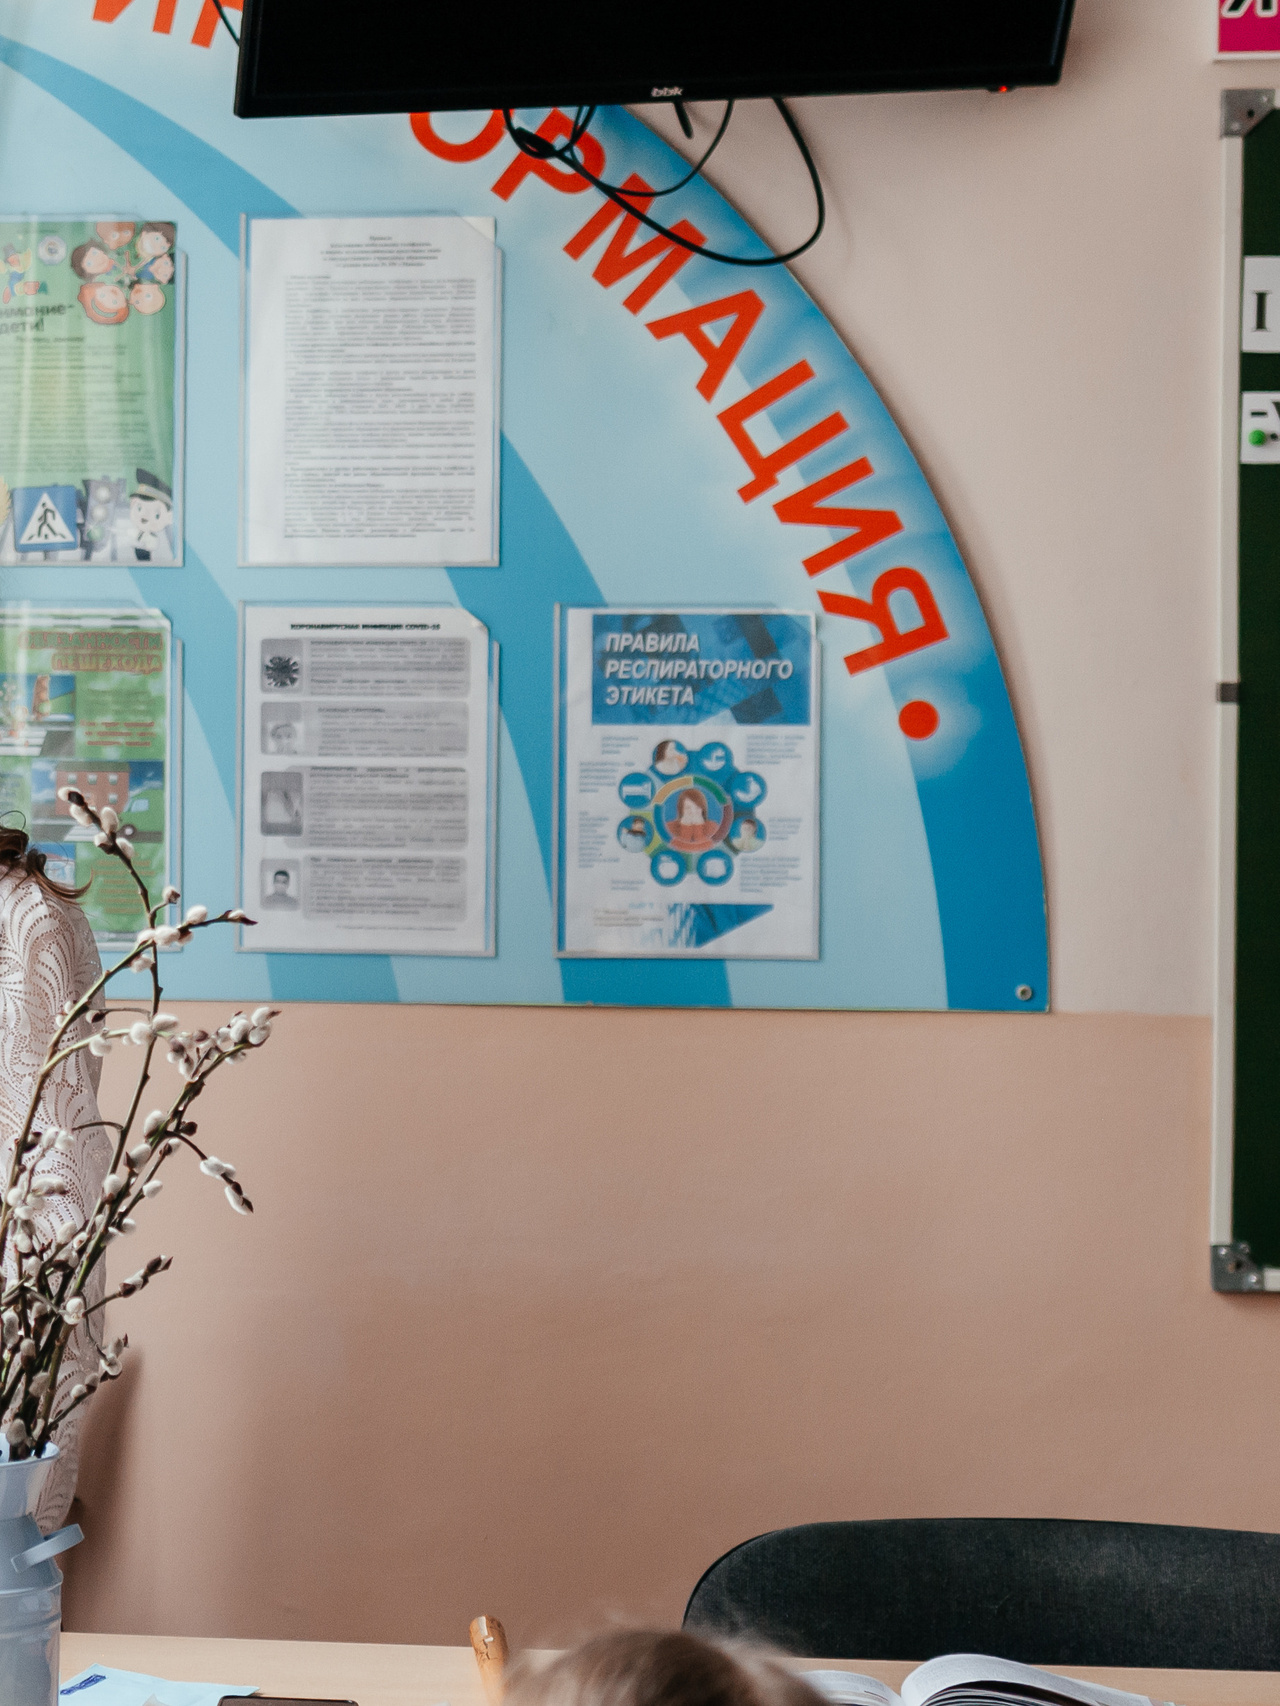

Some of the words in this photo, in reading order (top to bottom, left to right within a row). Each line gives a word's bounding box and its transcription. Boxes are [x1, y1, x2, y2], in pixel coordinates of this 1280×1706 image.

[605, 633, 700, 653] ПРАВИЛА
[604, 659, 794, 680] РЕСПИРАТОРНОГО
[605, 685, 696, 706] ЭТИКЕТА
